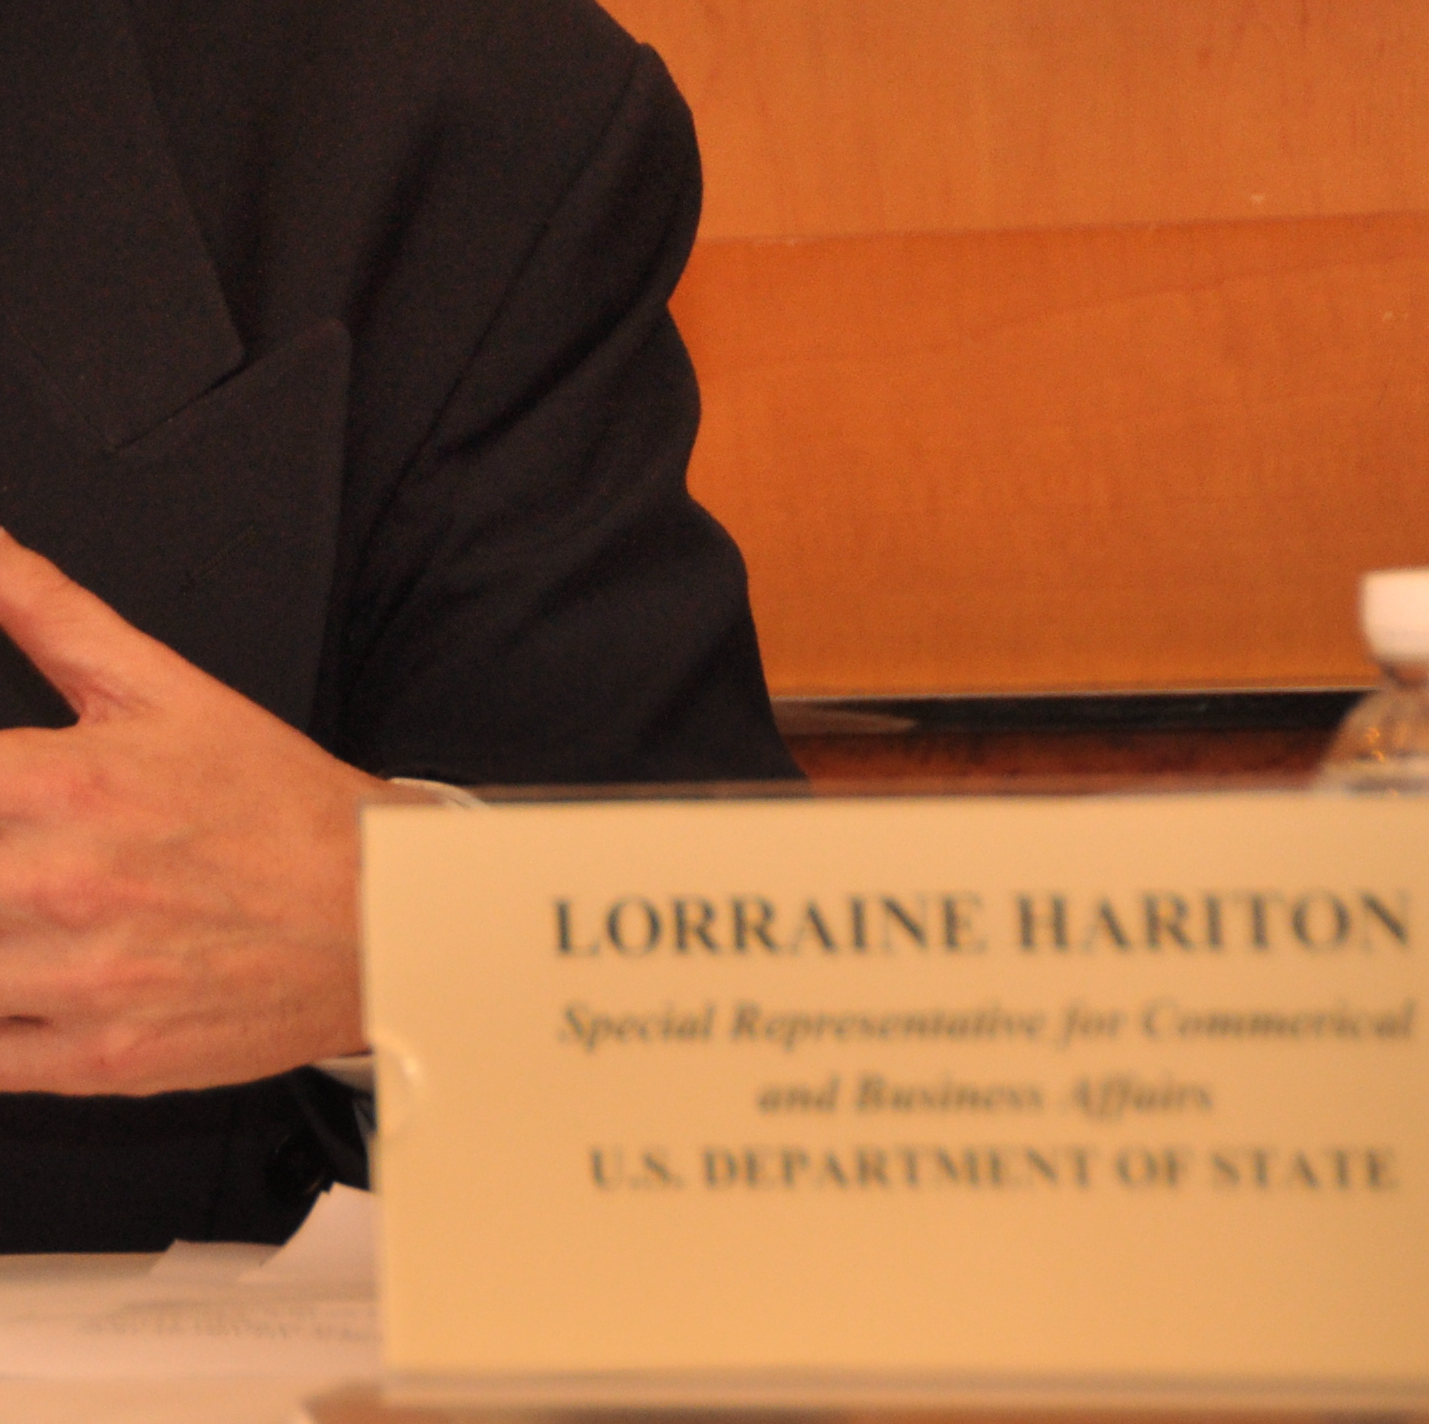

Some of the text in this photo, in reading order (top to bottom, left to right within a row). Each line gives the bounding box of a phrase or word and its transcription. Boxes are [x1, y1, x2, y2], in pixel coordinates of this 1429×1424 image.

[551, 889, 1414, 958] LORRAINE HARITON
[558, 1000, 717, 1056] Special
[728, 1000, 1047, 1054] Representative
[1055, 1000, 1127, 1052] for
[756, 1070, 1215, 1122] and Business Affairs
[585, 1145, 1401, 1192] U.S. DEPARTMENT OF STATE
